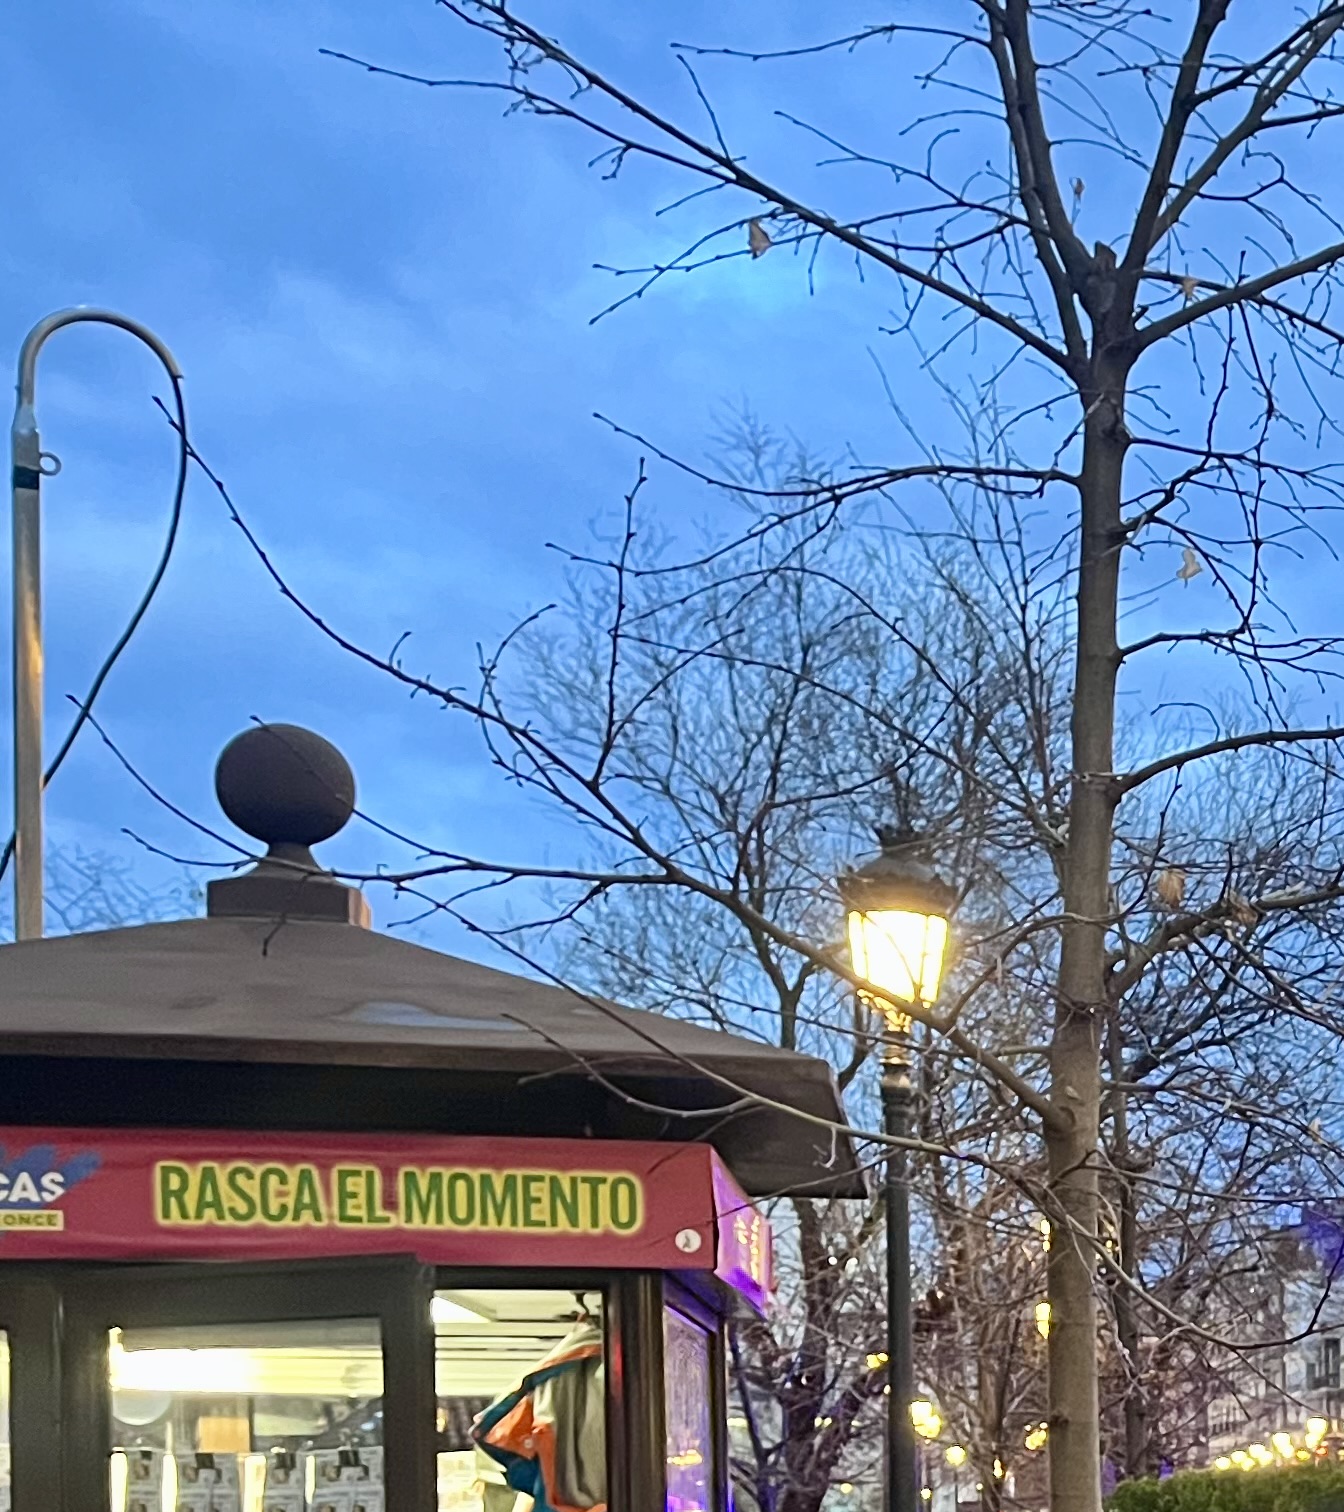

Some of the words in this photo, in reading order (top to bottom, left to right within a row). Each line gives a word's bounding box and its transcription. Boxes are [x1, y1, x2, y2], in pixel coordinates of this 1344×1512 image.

[160, 1164, 323, 1224] RASCA
[337, 1168, 391, 1224] EL
[404, 1171, 639, 1231] MOMENTO
[3, 1213, 58, 1227] ONCE
